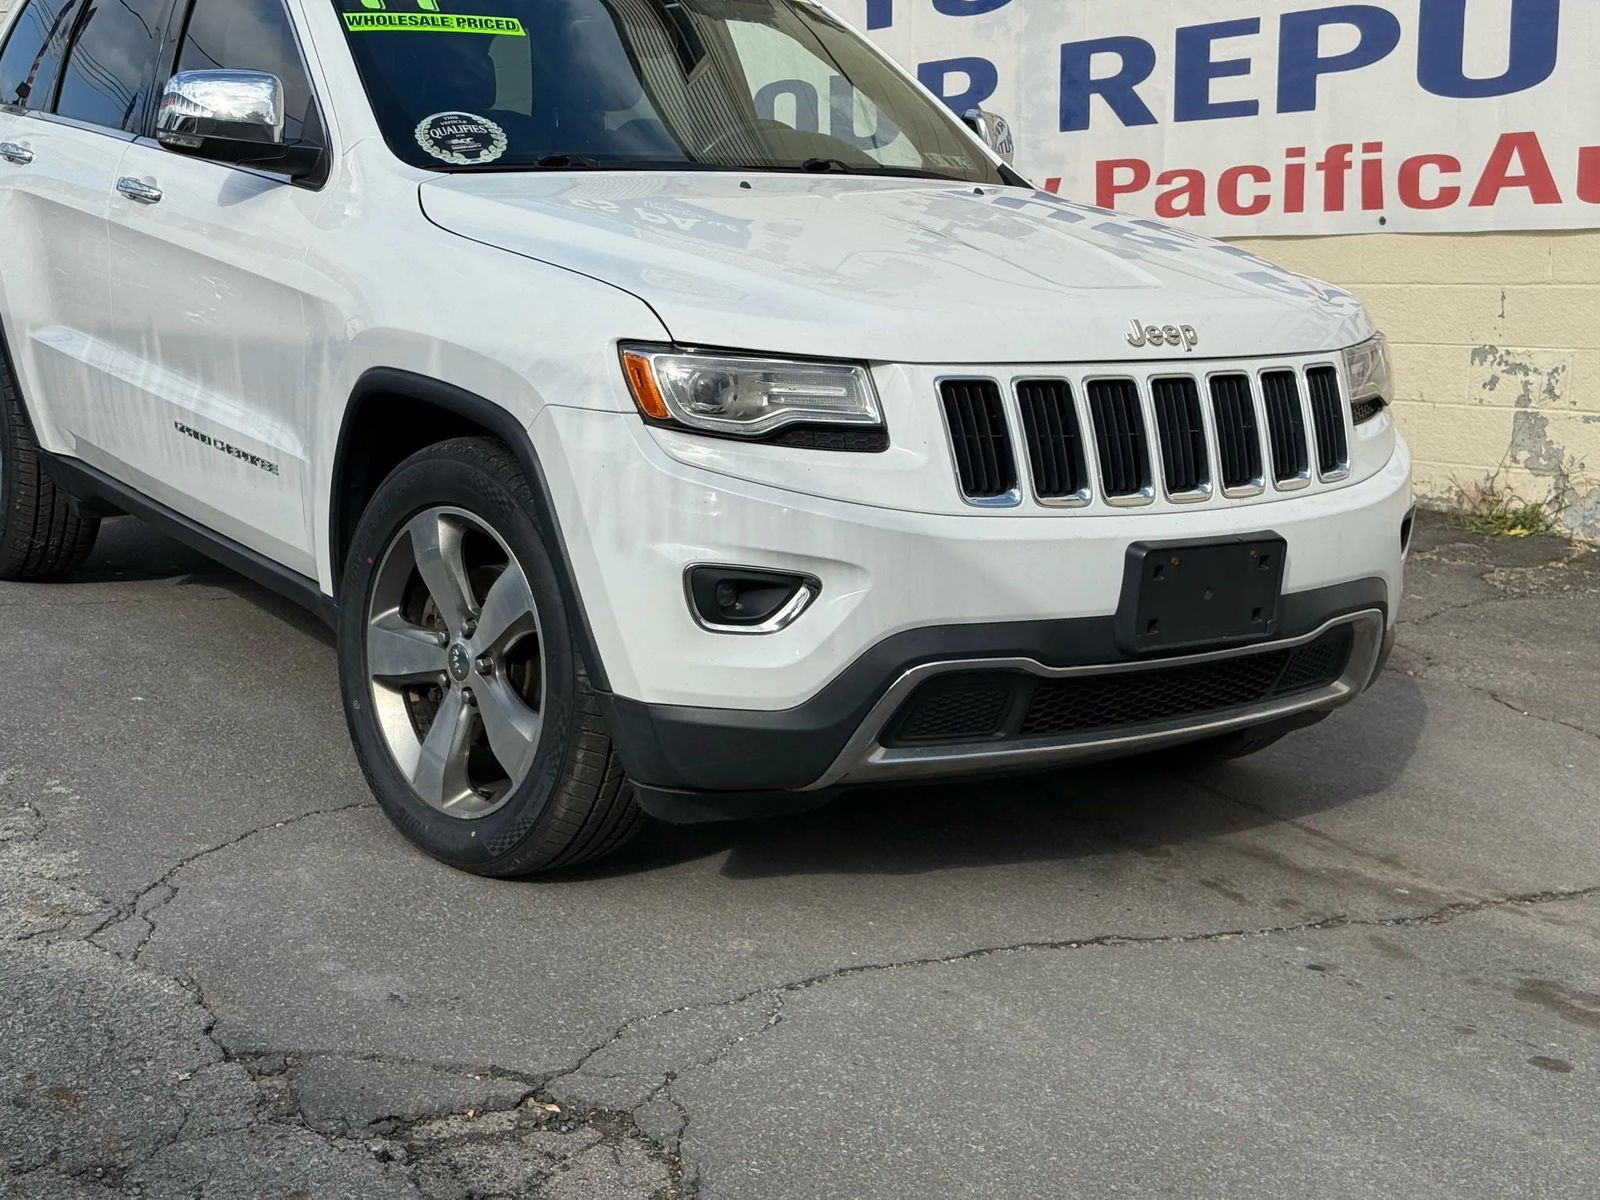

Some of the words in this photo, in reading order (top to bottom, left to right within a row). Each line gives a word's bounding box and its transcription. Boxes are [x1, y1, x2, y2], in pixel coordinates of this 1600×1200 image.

[346, 14, 450, 28] WHOLESALE
[456, 17, 517, 31] PRICED
[429, 124, 488, 139] QUALIFIES
[1123, 319, 1198, 352] Jeep
